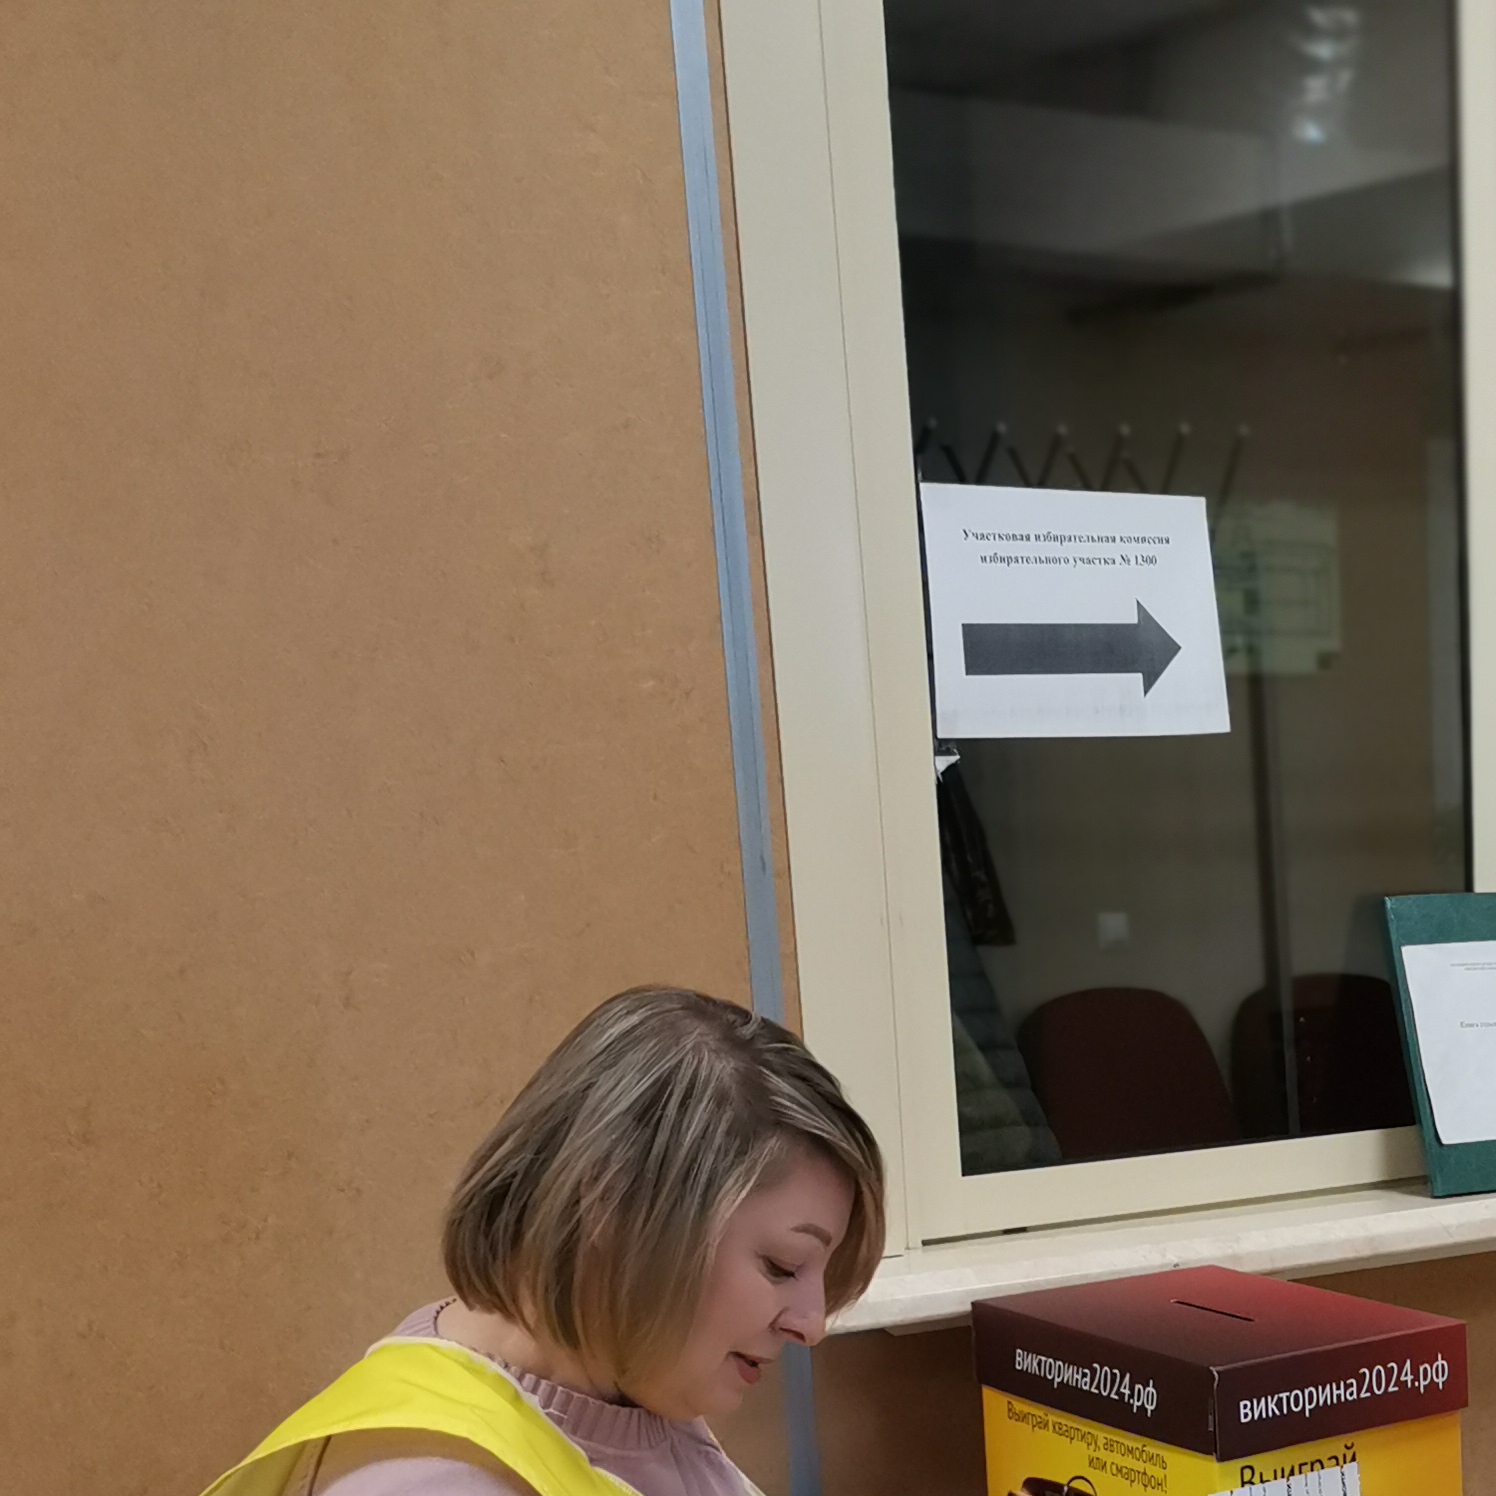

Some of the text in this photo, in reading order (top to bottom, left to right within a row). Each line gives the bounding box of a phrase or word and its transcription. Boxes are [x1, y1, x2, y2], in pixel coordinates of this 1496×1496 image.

[962, 528, 1171, 547] Участковая избирательная комиссия
[980, 552, 1158, 568] избирательного участка № 1300
[1015, 1348, 1158, 1418] викторина2024.рф
[1239, 1352, 1449, 1424] викторина2024.рф
[1006, 1400, 1168, 1471] Выиграй квартиру, автомобиль
[1088, 1454, 1168, 1494] или смартфон!
